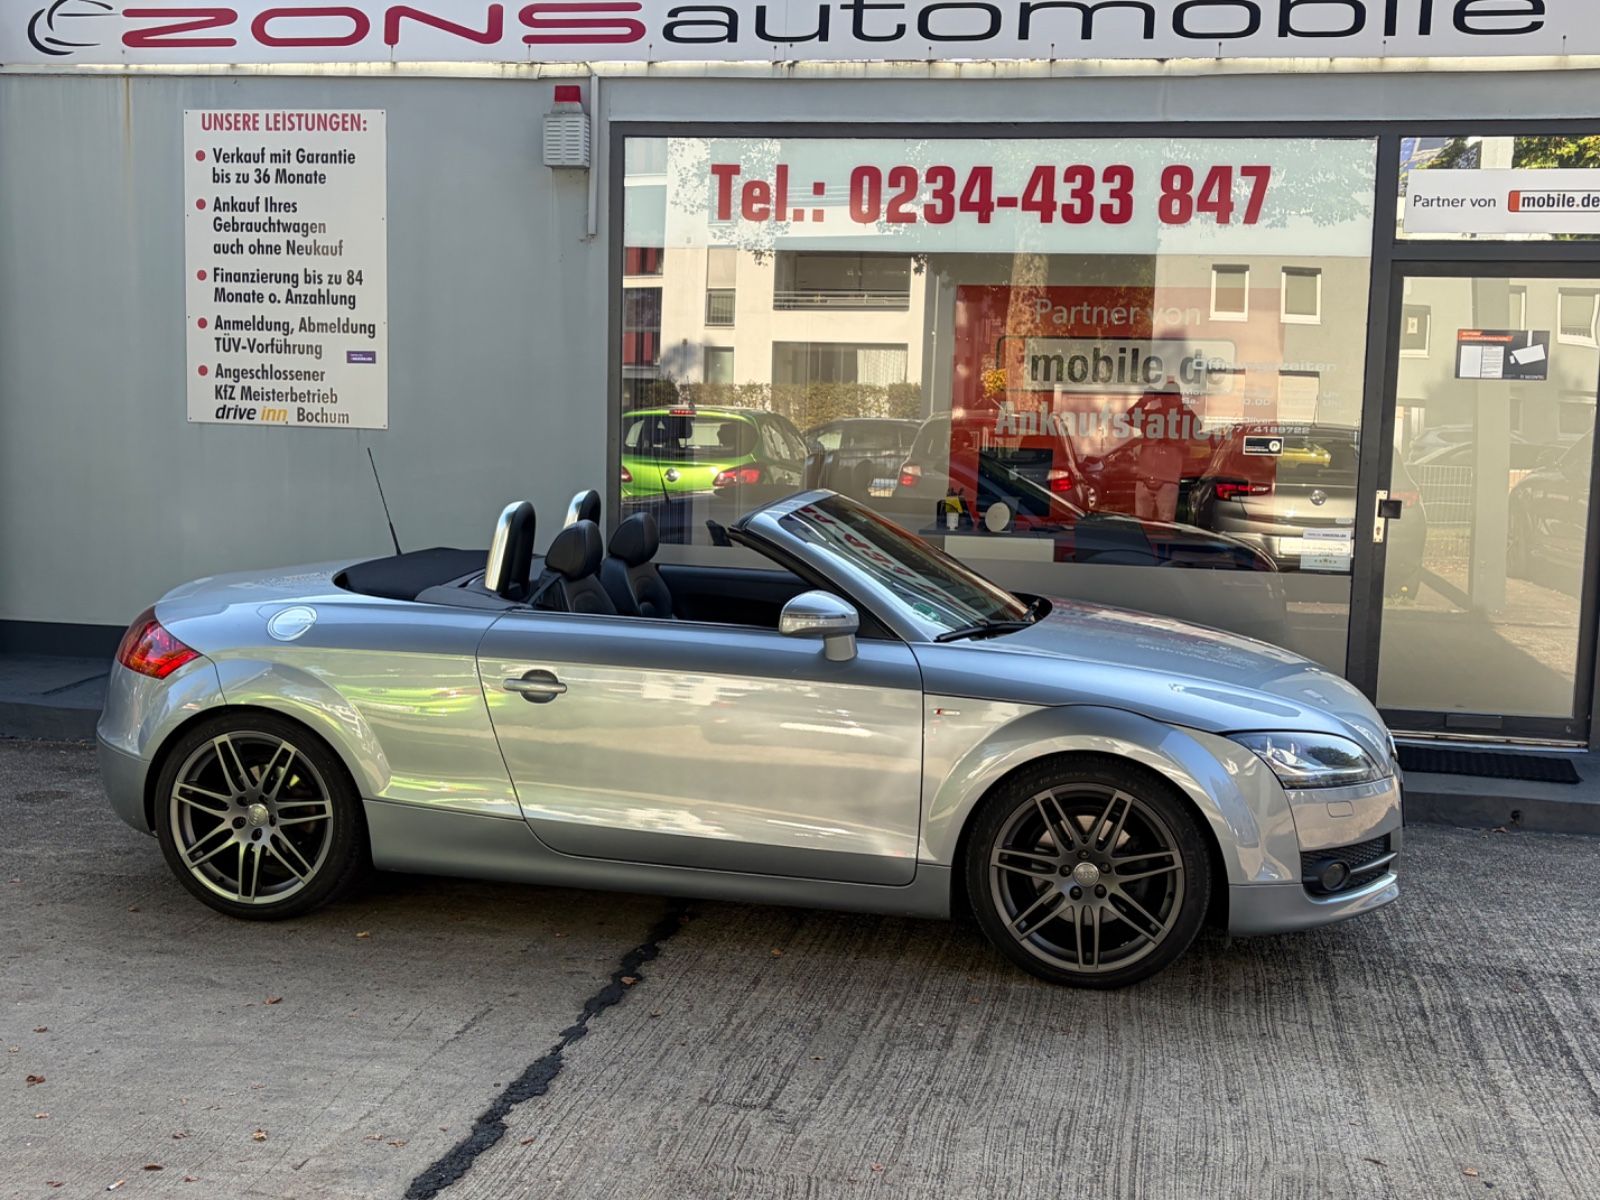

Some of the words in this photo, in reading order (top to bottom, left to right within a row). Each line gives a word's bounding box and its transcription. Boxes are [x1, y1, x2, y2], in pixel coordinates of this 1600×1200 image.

[201, 113, 259, 131] UNSERE
[265, 113, 367, 132] LEISTUNGEN:
[213, 147, 265, 164] Verkauf
[270, 149, 291, 163] mit
[296, 149, 356, 164] Garantie
[212, 167, 231, 184] bis
[235, 171, 249, 184] zu
[254, 168, 270, 184] 36
[275, 169, 326, 184] Monate
[710, 164, 825, 222] Tel.:
[849, 165, 1134, 224] 0234-433
[1157, 164, 1272, 224] 847
[1413, 194, 1466, 208] Partner
[1470, 198, 1497, 208] von
[1521, 193, 1600, 209] mobile.de
[213, 196, 260, 213] Ankauf
[265, 197, 298, 213] Ihres
[213, 217, 326, 237] Gebrauchtwagen
[213, 238, 244, 254] auch
[248, 239, 281, 255] ohne
[286, 240, 343, 256] Neukauf
[213, 267, 299, 288] Finanzierung
[304, 268, 323, 284] bis
[327, 272, 342, 285] zu
[347, 270, 363, 285] 84
[214, 288, 264, 303] Monate
[268, 291, 281, 304] o.
[285, 289, 356, 310] Anzahlung
[1034, 298, 1141, 326] Partner
[1149, 307, 1201, 326] von
[214, 315, 294, 336] Anmeldung,
[299, 317, 376, 338] Abmeldung
[214, 334, 322, 360] TÜV-Vorführung
[215, 363, 325, 383] Angeschlossener
[215, 384, 236, 400] KfZ
[240, 385, 338, 404] Meisterbetrieb
[215, 404, 257, 420] drive
[297, 407, 349, 424] Bochum
[994, 401, 1233, 441] Ankaufstation
